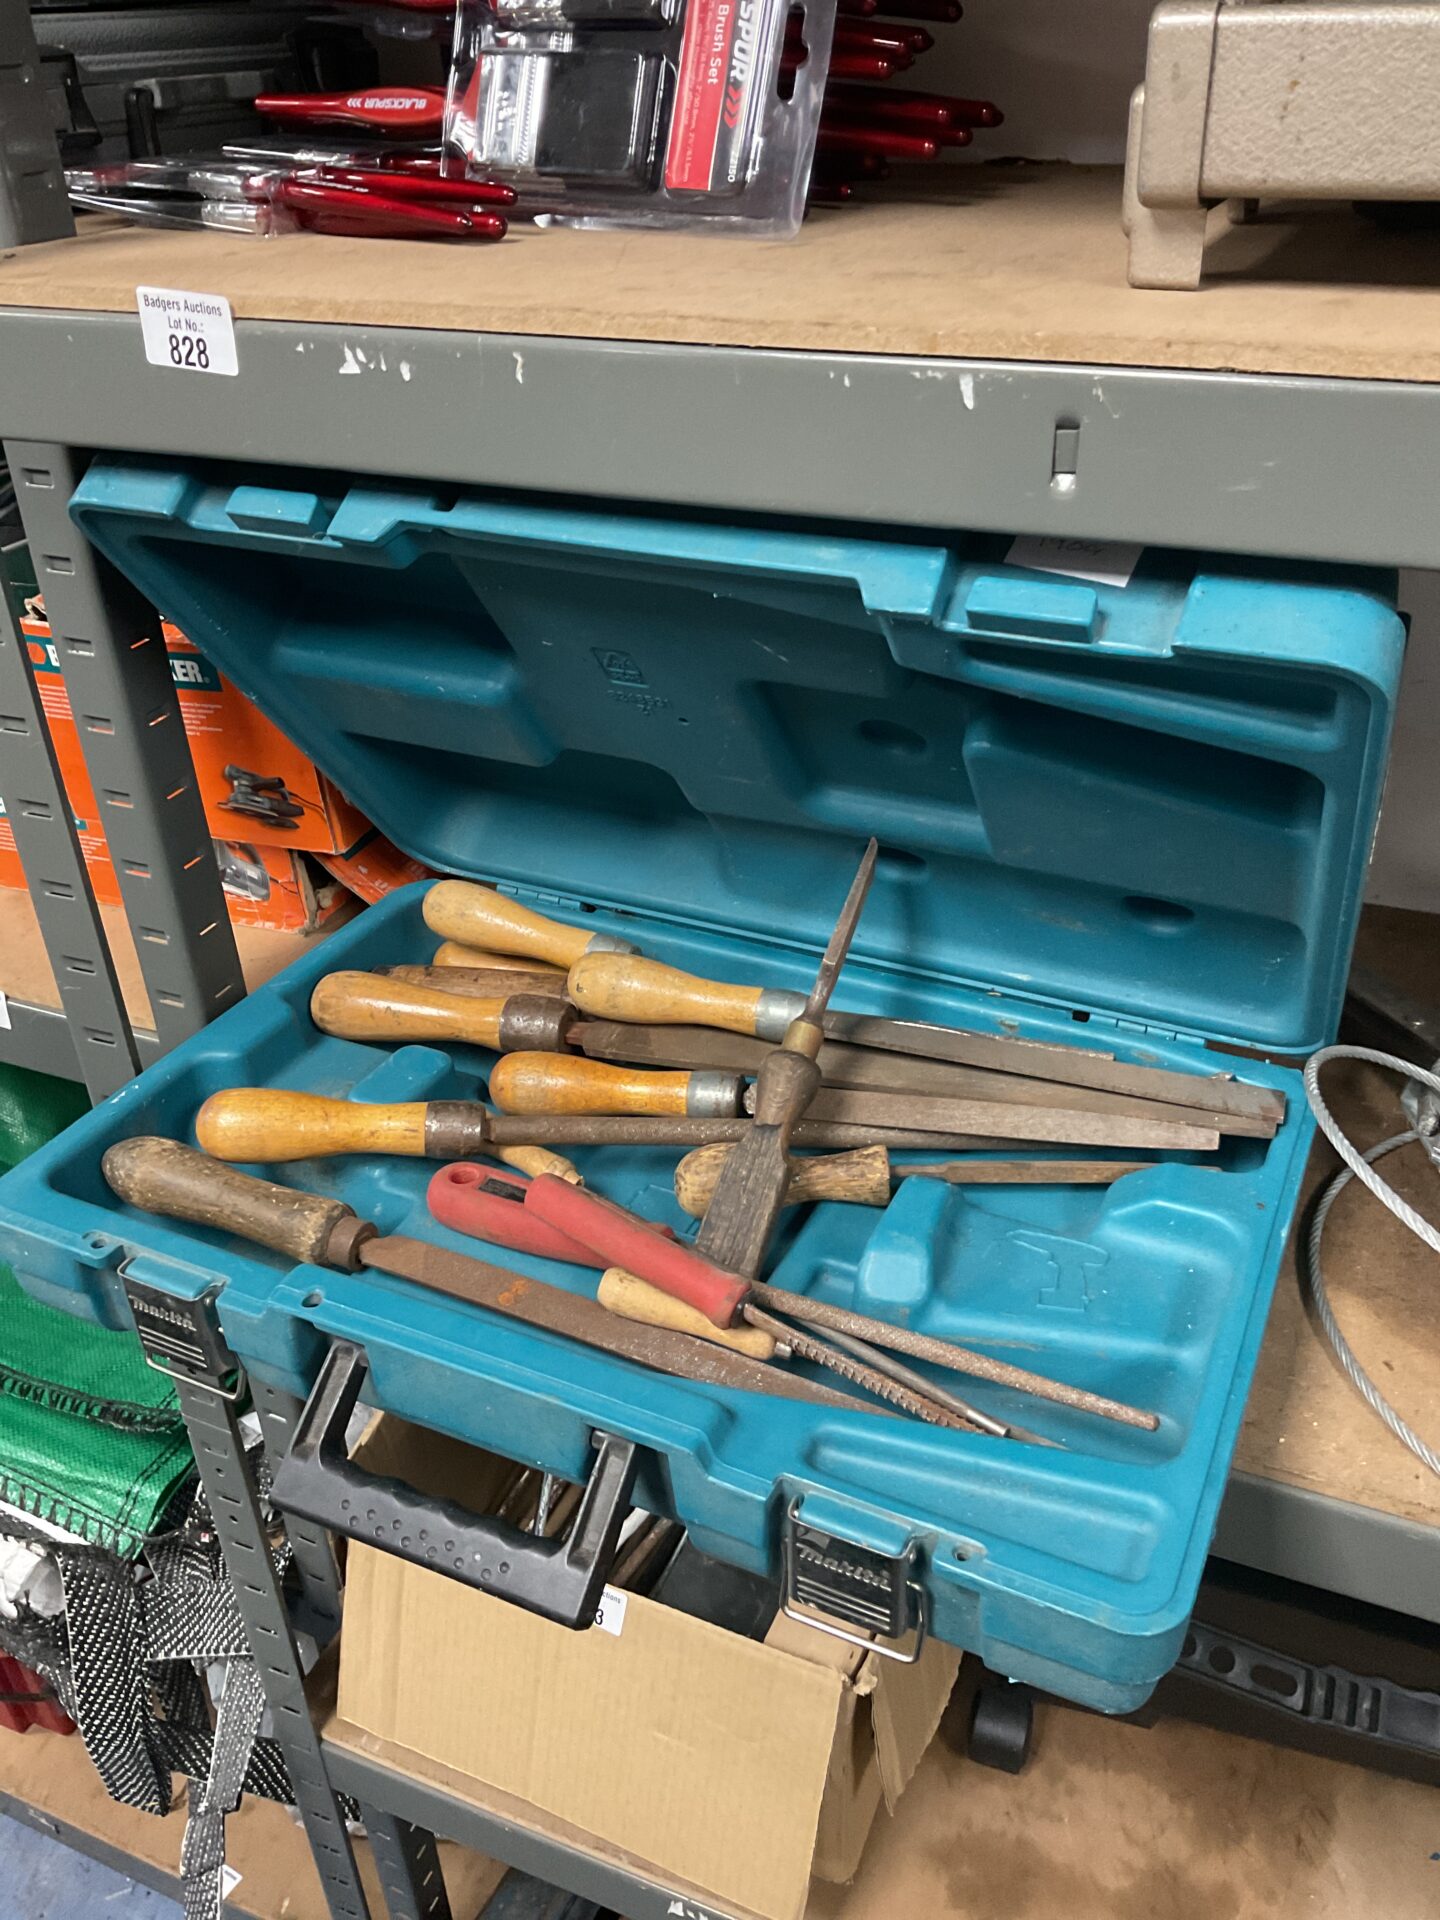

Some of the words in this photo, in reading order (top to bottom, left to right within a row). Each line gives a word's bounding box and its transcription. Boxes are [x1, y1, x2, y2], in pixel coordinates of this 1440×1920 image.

[712, 4, 729, 52] Brush
[707, 57, 722, 85] Set
[364, 97, 428, 109] BLACKSPUR
[143, 294, 180, 312] Badgers
[184, 299, 222, 316] Auctions
[168, 316, 182, 330] Lot
[185, 318, 204, 333] No.:
[169, 334, 210, 369] 828
[128, 1294, 197, 1332] makita
[796, 1542, 892, 1592] makita
